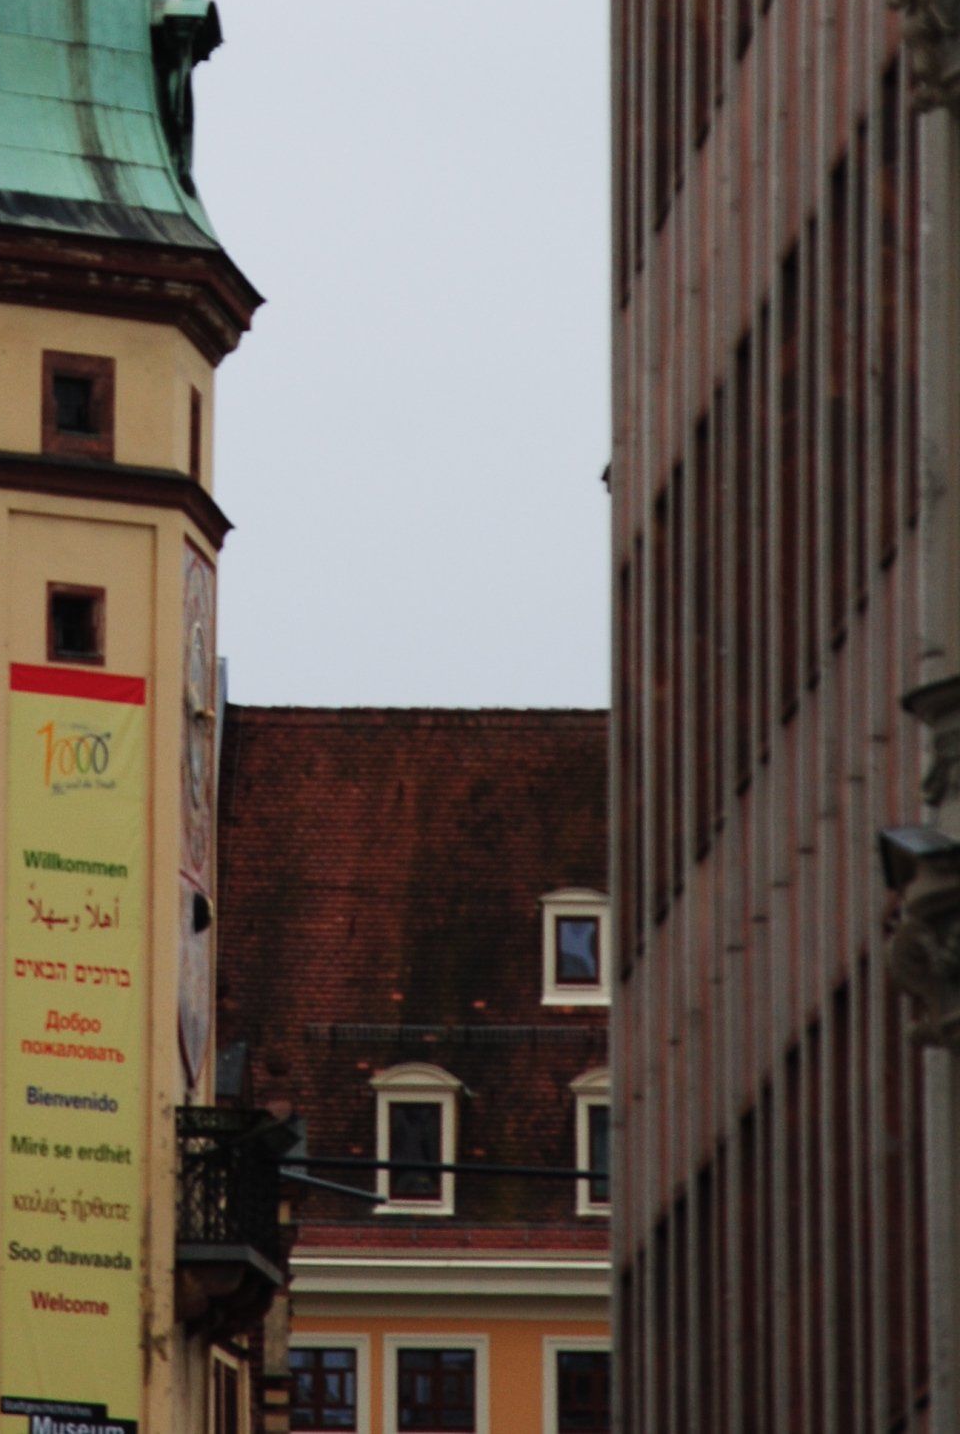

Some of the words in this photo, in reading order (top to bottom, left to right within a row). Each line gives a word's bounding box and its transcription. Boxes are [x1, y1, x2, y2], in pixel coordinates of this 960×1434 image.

[36, 719, 111, 790] 1000
[23, 850, 128, 879] Willkommen
[15, 957, 67, 982] הבאים
[75, 964, 130, 987] ברוכים
[45, 1009, 101, 1035] Добро
[21, 1039, 125, 1064] пожаловать
[26, 1085, 119, 1114] Bienvenido
[54, 1143, 72, 1159] se
[8, 1240, 42, 1262] Soo
[46, 1244, 133, 1271] dhawaada
[30, 1290, 109, 1316] Welcome
[32, 1415, 125, 1434] Museum
